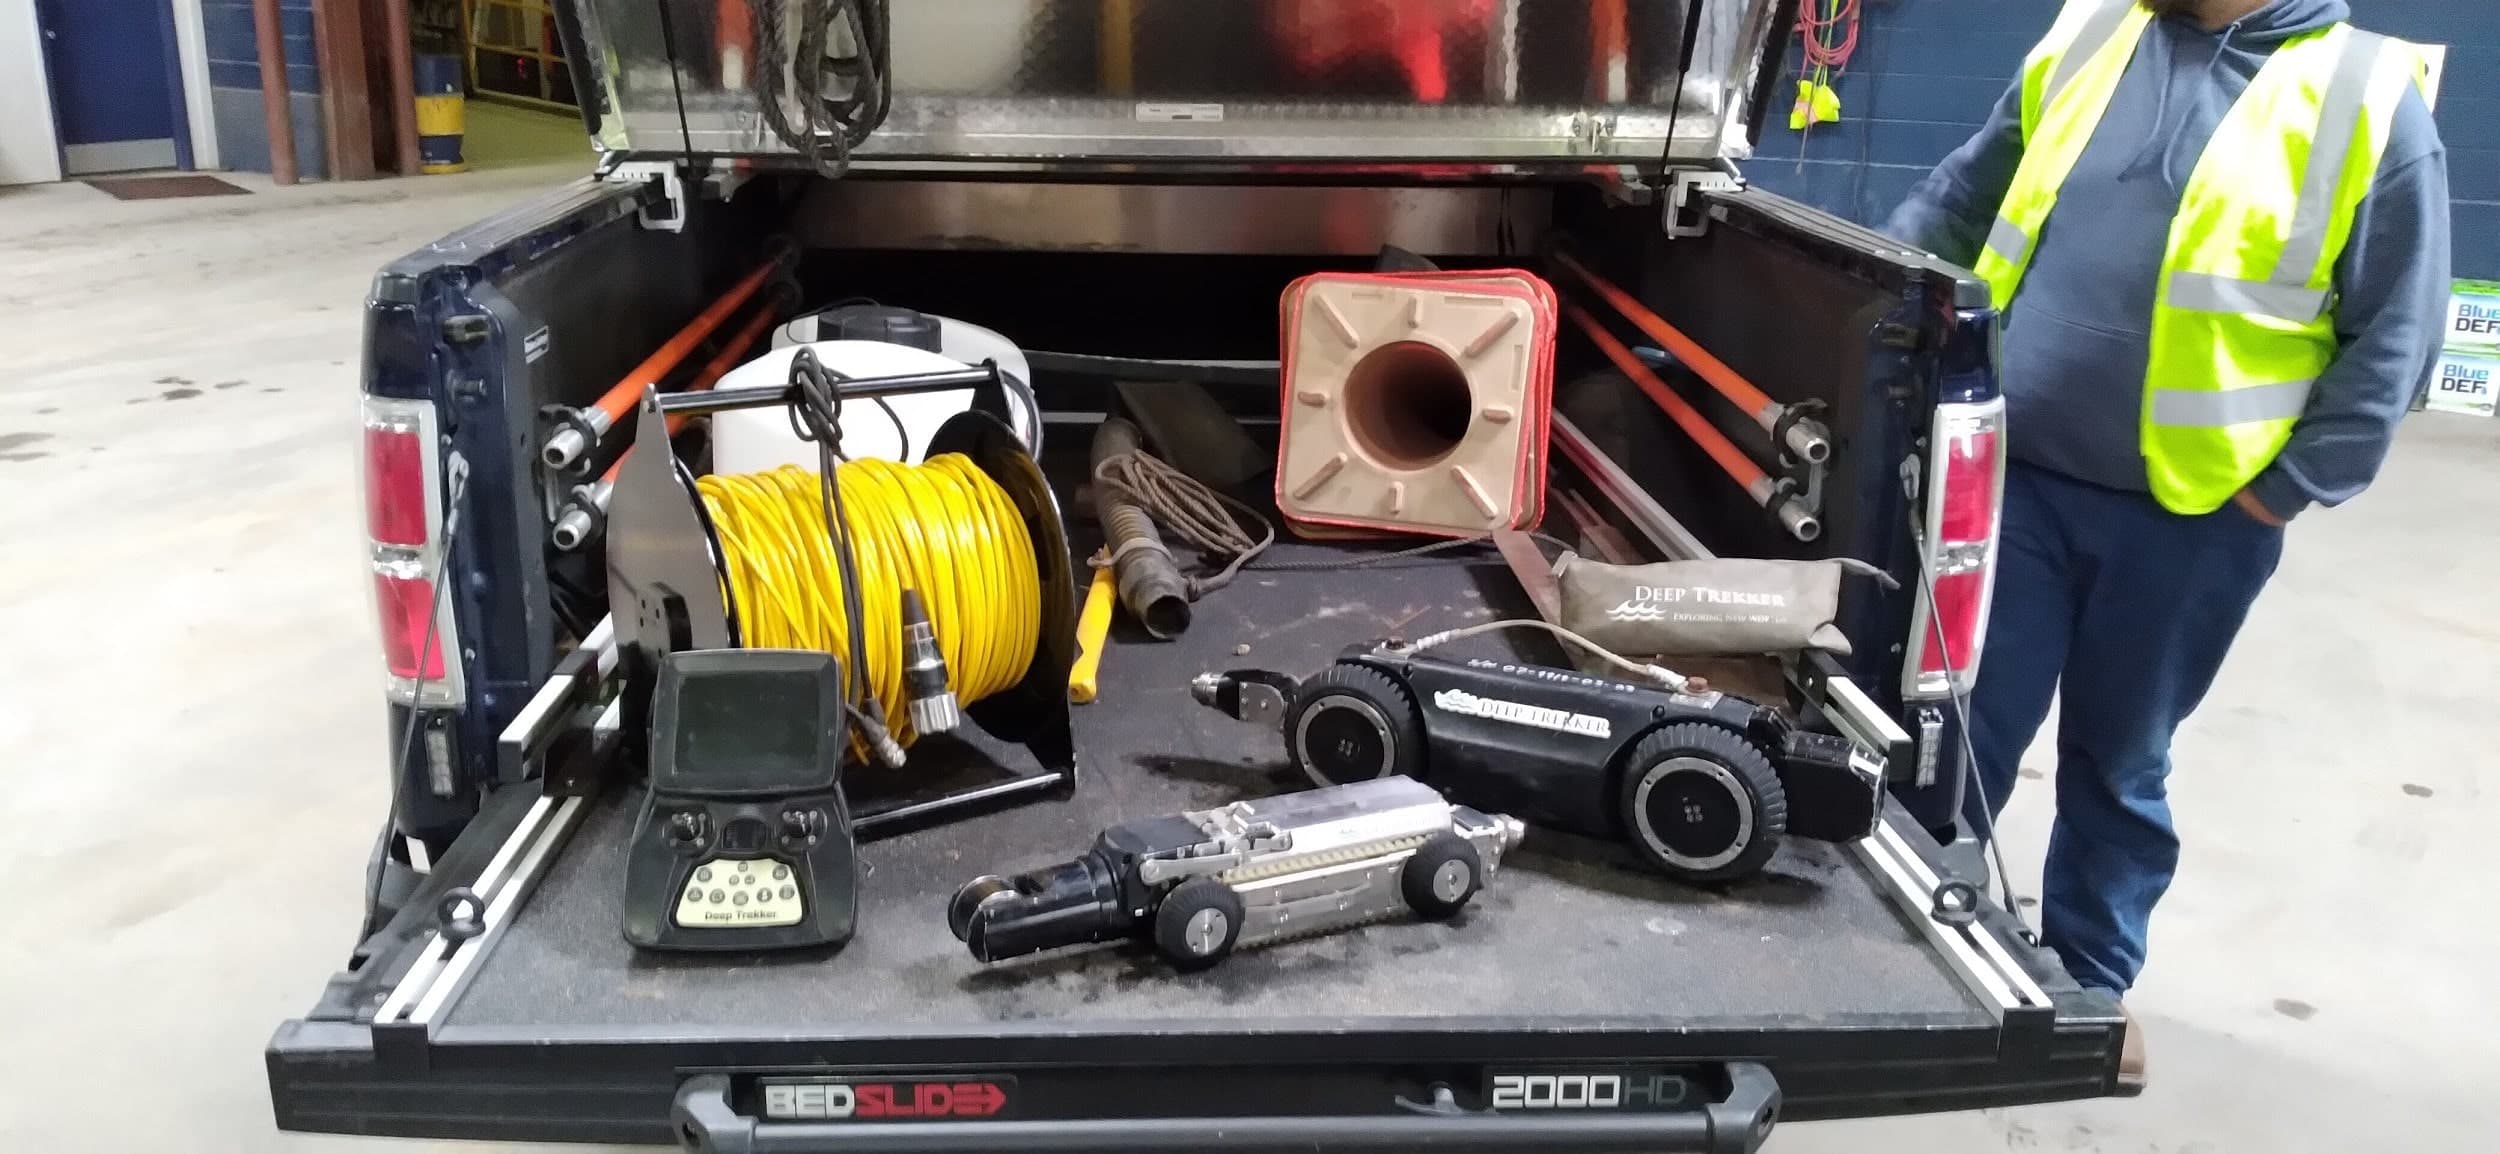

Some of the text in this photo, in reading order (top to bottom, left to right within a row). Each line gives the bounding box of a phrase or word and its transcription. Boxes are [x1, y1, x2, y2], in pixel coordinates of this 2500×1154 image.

[2458, 304, 2500, 319] Blue
[2455, 317, 2500, 334] DEF
[2443, 364, 2489, 380] Blue
[2440, 377, 2488, 395] DEF
[1635, 585, 1786, 608] DEEP TREKKER
[1480, 700, 1611, 733] DEEP TREKKER
[704, 909, 776, 923] Deep Trekker
